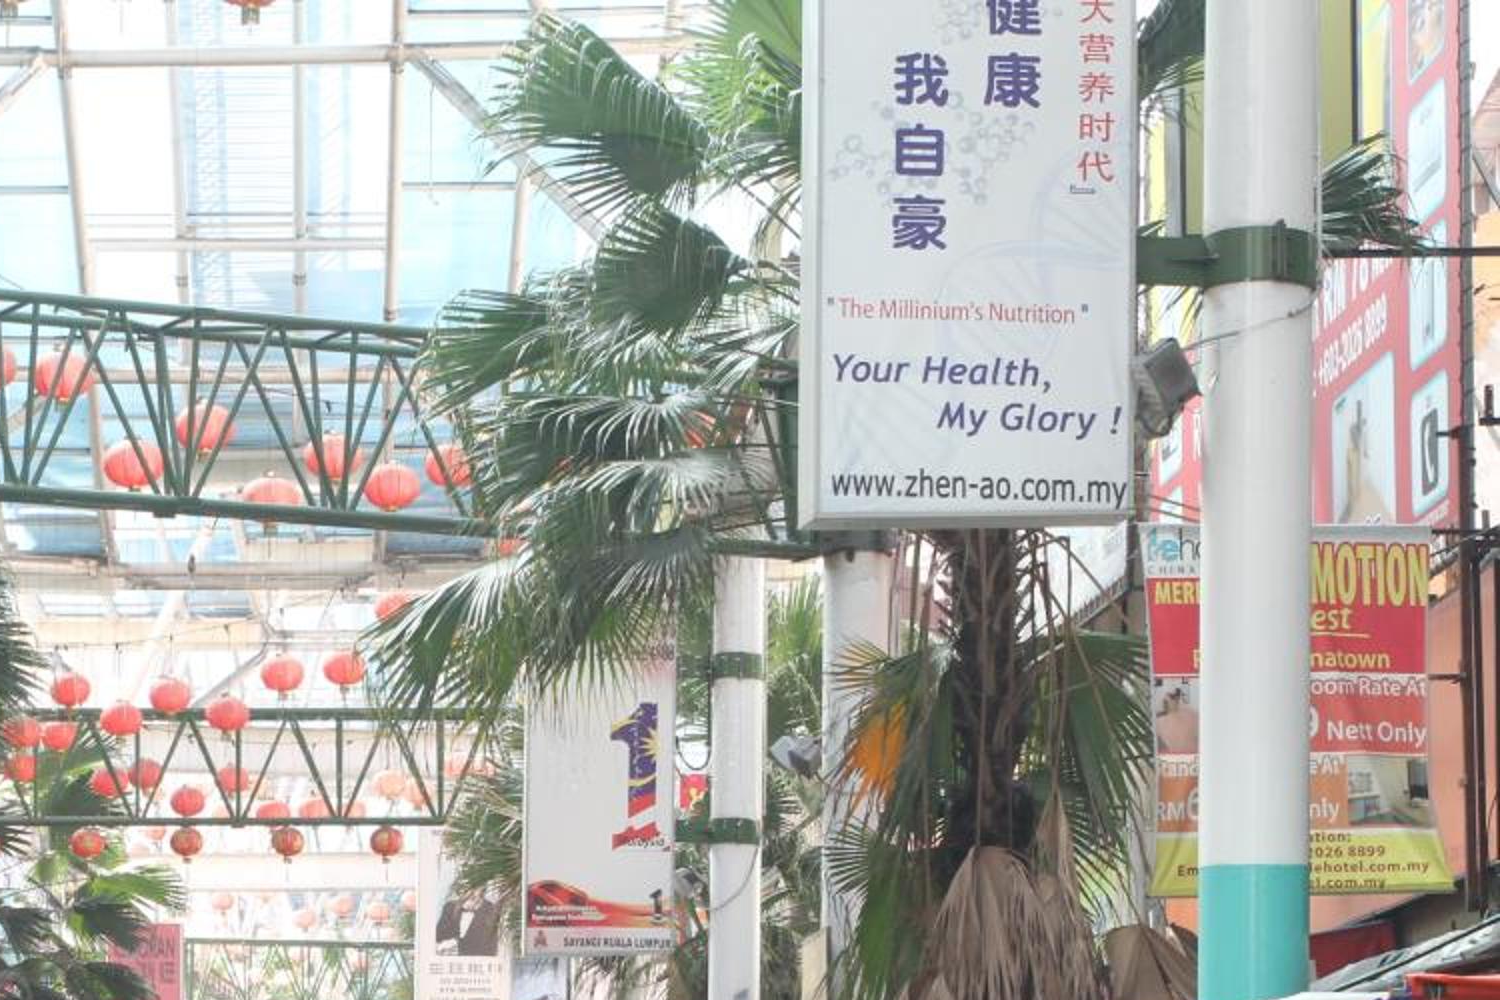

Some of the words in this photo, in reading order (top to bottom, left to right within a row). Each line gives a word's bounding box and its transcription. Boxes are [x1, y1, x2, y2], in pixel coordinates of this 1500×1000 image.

[879, 299, 984, 322] Millinium's
[989, 303, 1075, 325] Nutrition
[832, 353, 910, 384] Your
[922, 356, 1053, 394] Health,
[937, 401, 988, 437] My
[831, 467, 1128, 509] www.zhen-ao.com.my
[1358, 677, 1402, 697] Rate
[1327, 719, 1373, 742] Nett
[1377, 720, 1428, 750] Only
[1347, 845, 1386, 857] 8899
